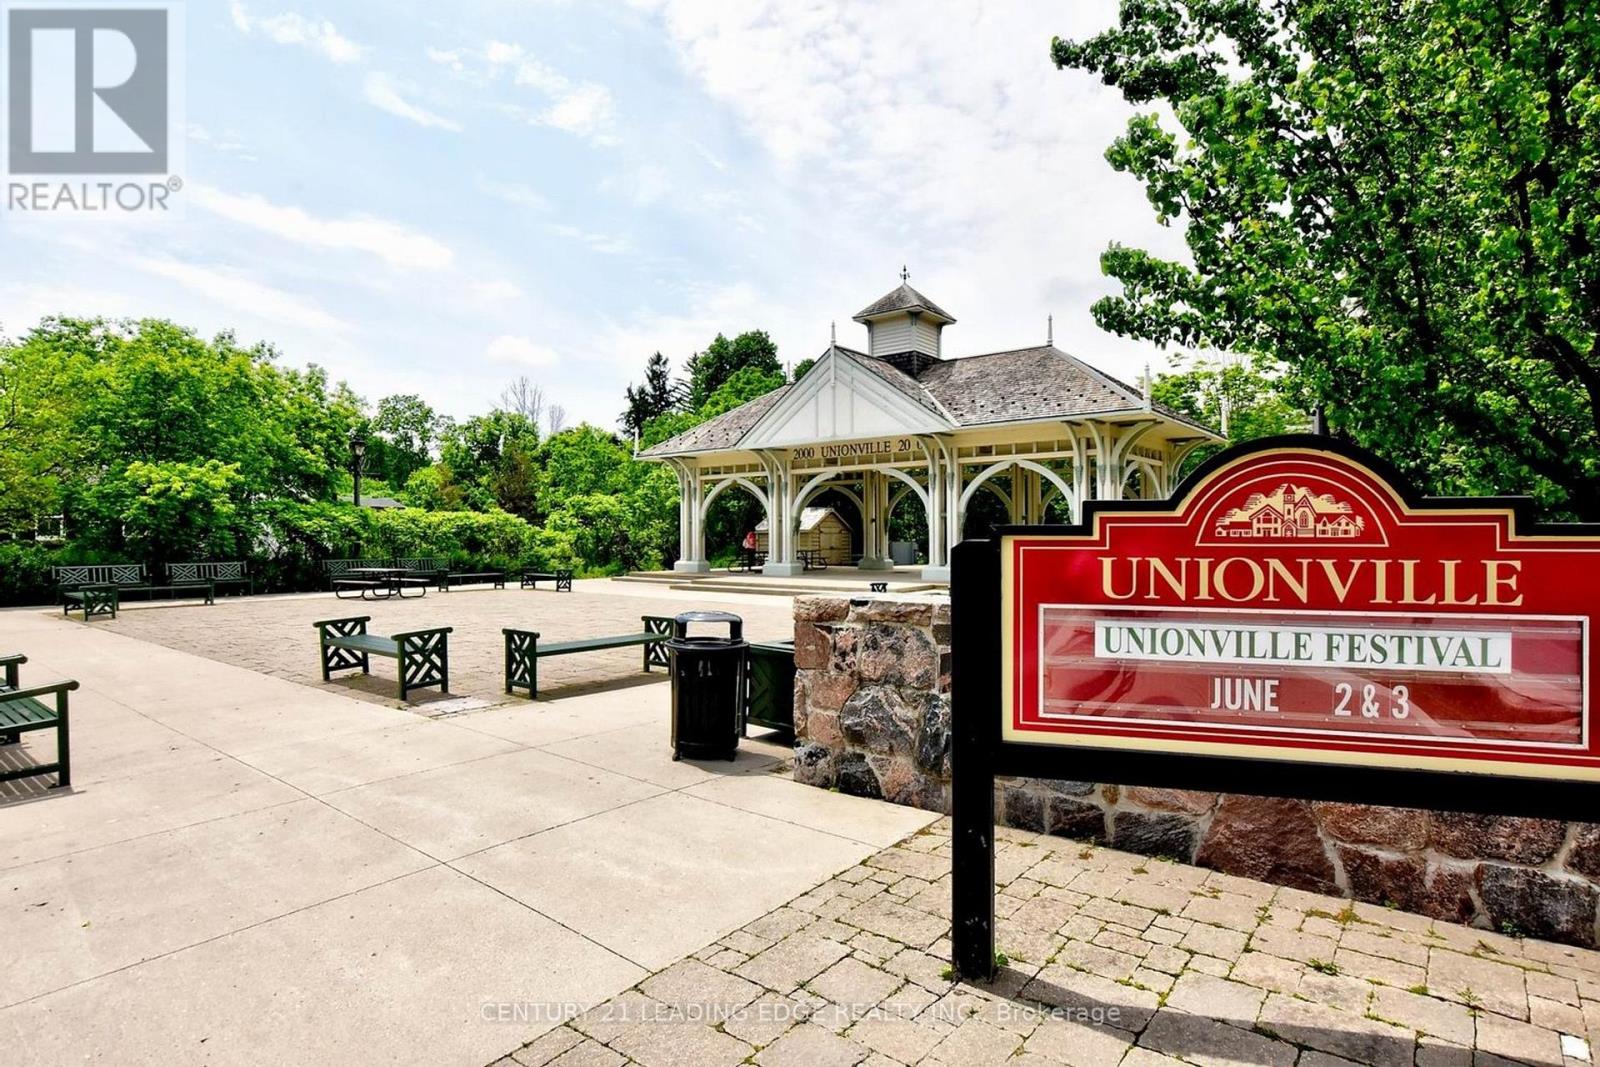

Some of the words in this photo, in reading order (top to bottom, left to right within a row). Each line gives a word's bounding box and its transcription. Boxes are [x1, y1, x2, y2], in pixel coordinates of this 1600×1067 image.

[793, 447, 815, 460] 2000
[820, 440, 891, 457] UNIONVILLE
[1097, 556, 1524, 607] UNIONVILLE
[1104, 626, 1313, 661] UNIONVILLE
[1324, 632, 1502, 668] FESTIVAL
[1210, 677, 1280, 712] JUNE
[1334, 682, 1353, 716] 2
[1361, 683, 1380, 719] &
[1391, 685, 1410, 720] 3
